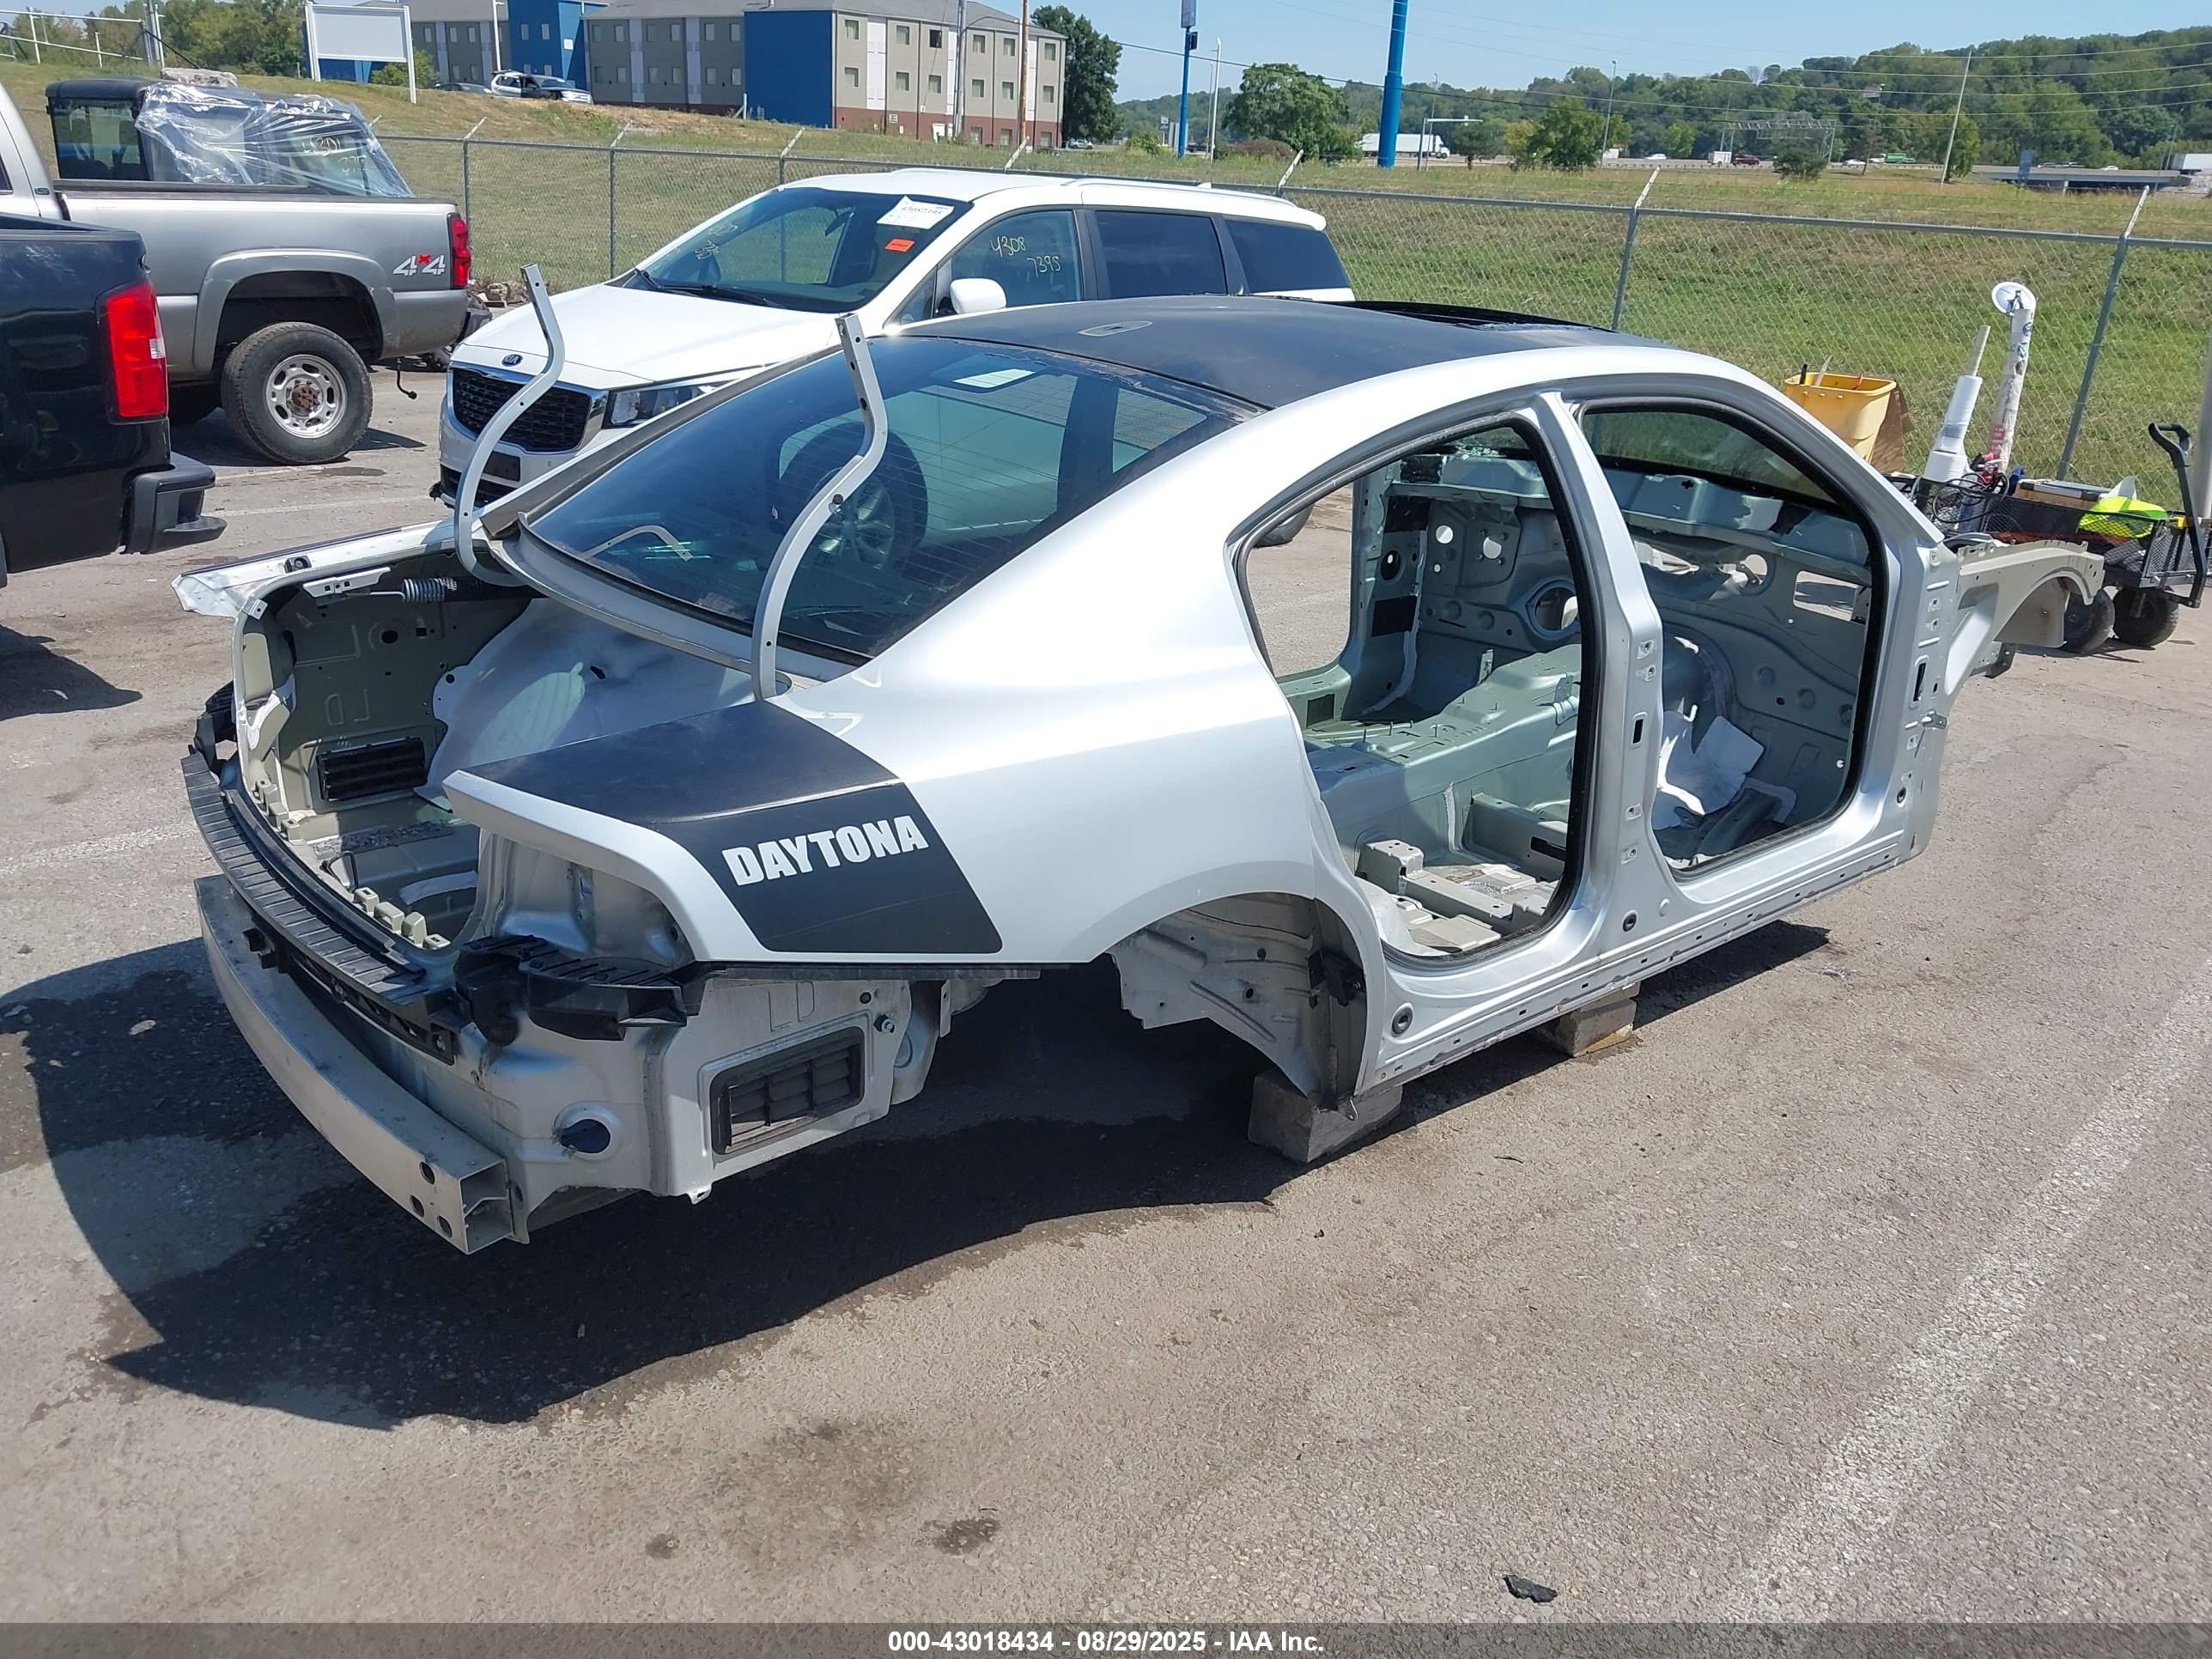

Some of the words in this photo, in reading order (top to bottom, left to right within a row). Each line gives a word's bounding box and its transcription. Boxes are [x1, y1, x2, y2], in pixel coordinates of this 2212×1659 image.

[990, 235, 1026, 258] 4308
[1026, 255, 1061, 277] 7395
[721, 815, 930, 887] DAYTONA
